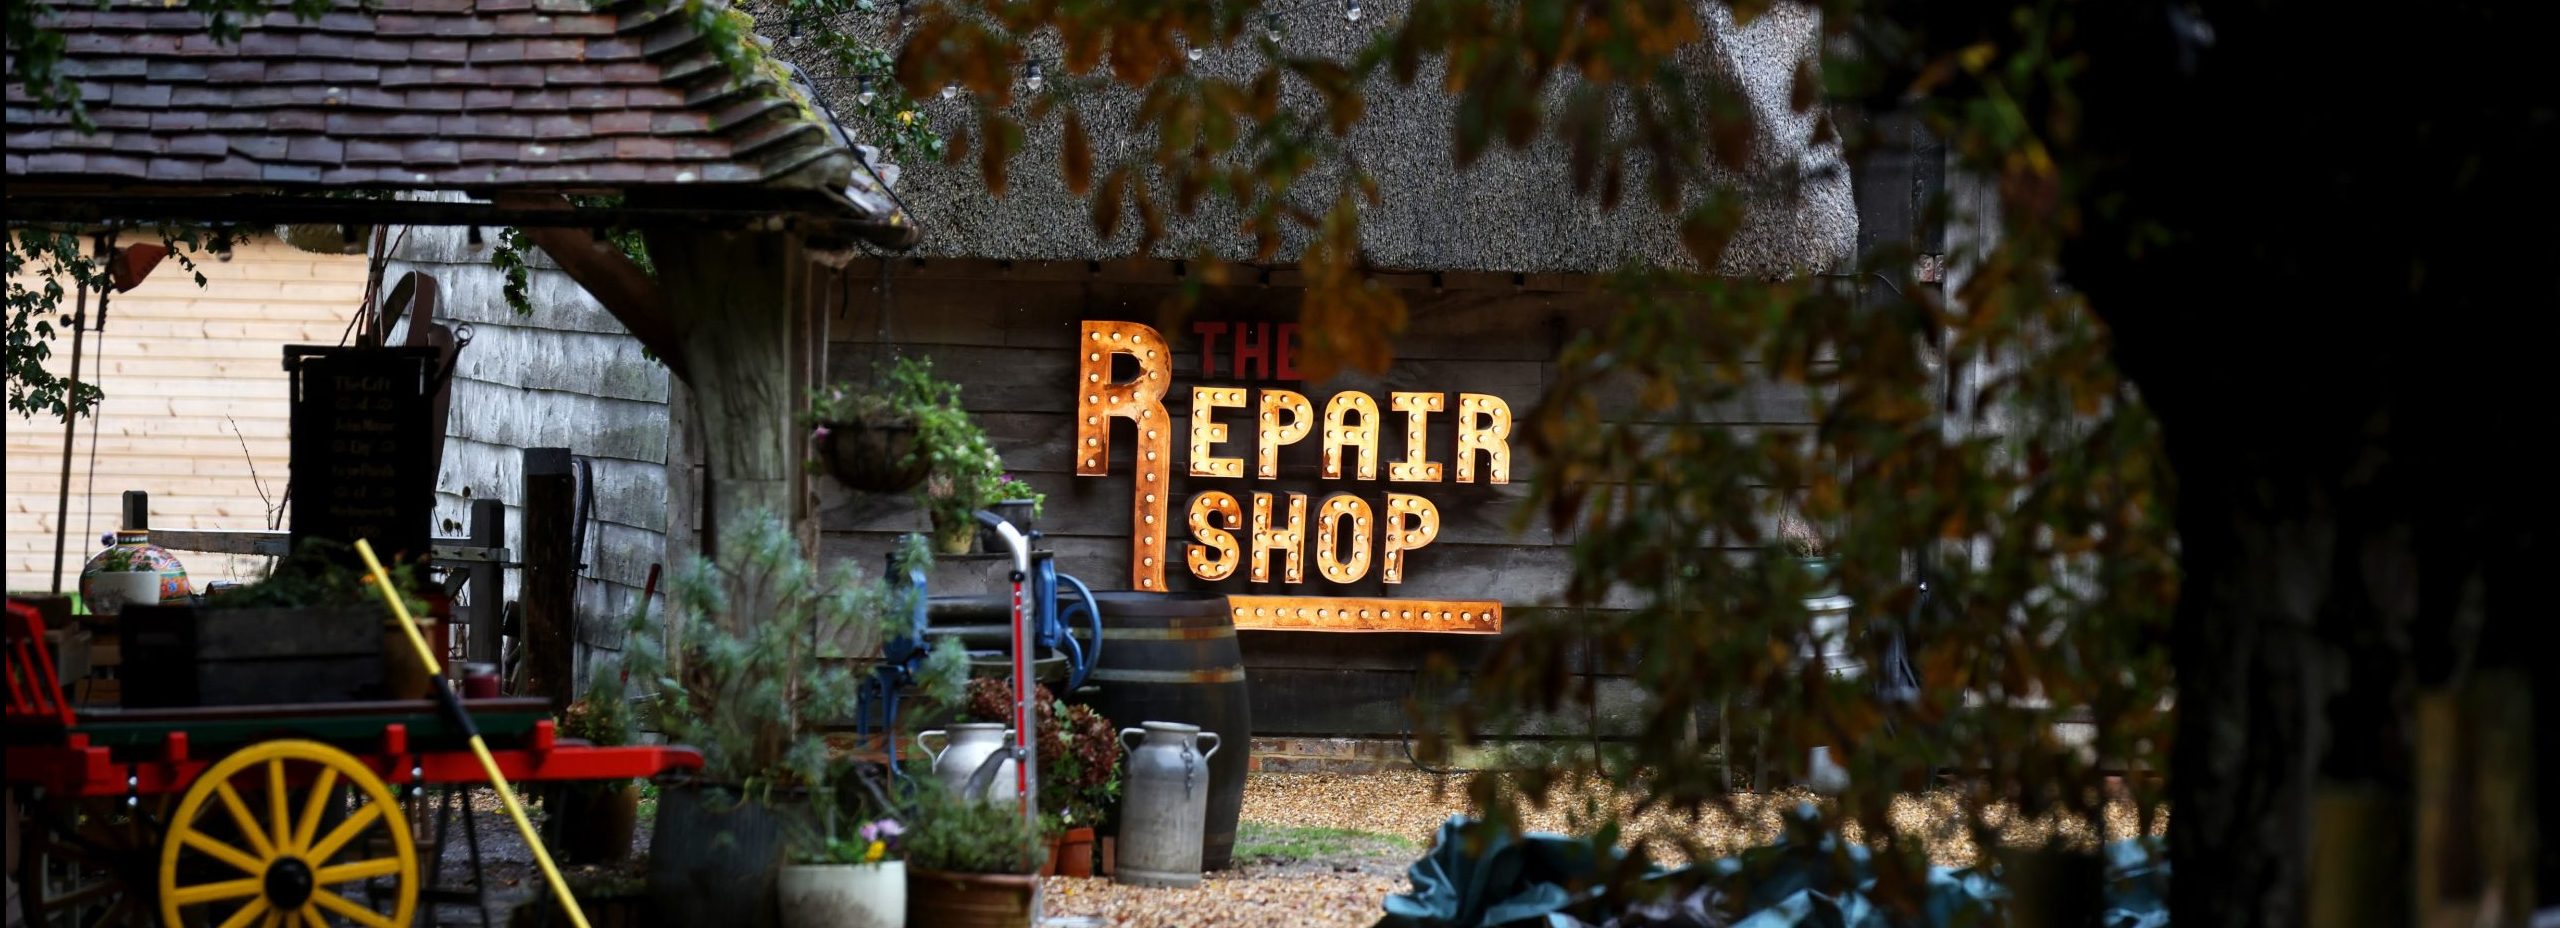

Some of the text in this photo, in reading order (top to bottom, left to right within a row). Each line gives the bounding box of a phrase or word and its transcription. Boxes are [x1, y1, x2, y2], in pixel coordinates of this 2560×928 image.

[1194, 322, 1300, 380] THE
[1077, 320, 1512, 592] REPAIR
[1187, 489, 1440, 584] SHOP
